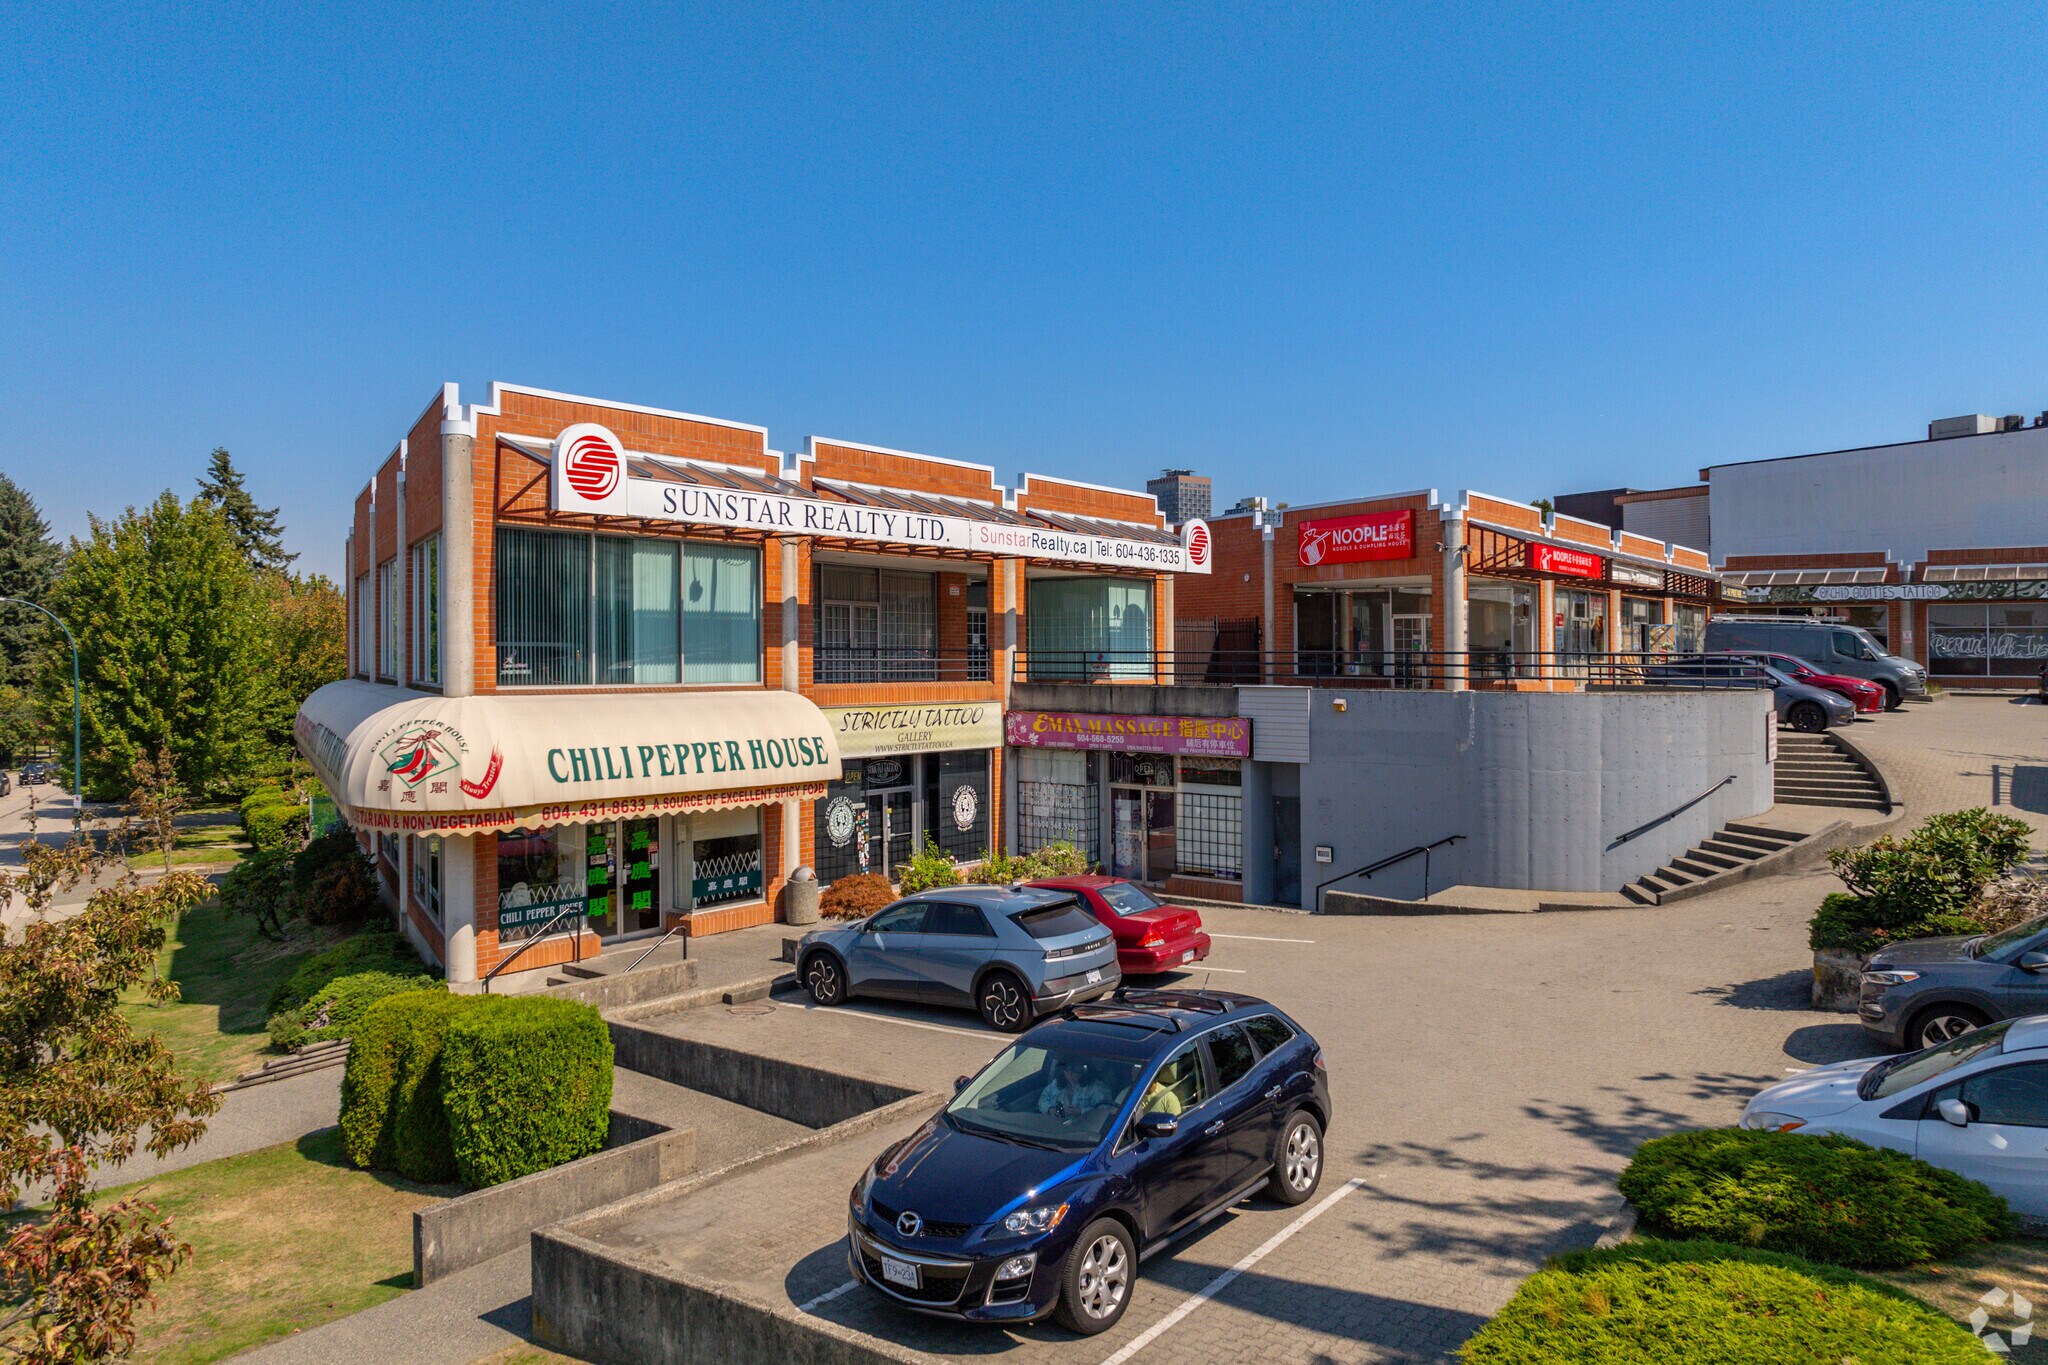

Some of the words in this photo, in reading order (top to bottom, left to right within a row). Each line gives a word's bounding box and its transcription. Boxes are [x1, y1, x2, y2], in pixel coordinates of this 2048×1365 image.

[663, 487, 792, 526] SUNSTAR
[803, 504, 897, 537] REALTY
[905, 516, 950, 543] LTD.
[1332, 525, 1387, 545] NOOPLE
[980, 527, 1087, 556] SunstarRealty.ca
[1096, 540, 1112, 557] Tel:
[1115, 543, 1180, 565] 604-436-1335
[1552, 550, 1572, 564] NOOPLE
[1853, 587, 1894, 598] ODDITIES
[1902, 586, 1940, 598] TATTOO
[840, 709, 922, 732] STRICTLY
[925, 707, 984, 727] TATTOO
[1086, 719, 1174, 737] MASSAGE
[897, 731, 934, 743] GALLERY
[1076, 734, 1125, 744] 604-568-5255
[1178, 719, 1245, 740] 指壓中心
[875, 741, 953, 753] WWW.STRICTLYTATTOO.CA
[547, 746, 634, 783] CHILI
[637, 740, 745, 777] PEPPER
[747, 736, 829, 769] HOUSE
[482, 762, 497, 790] Trusted
[845, 769, 862, 781] OPEN
[1134, 763, 1154, 776] OPEN
[463, 783, 484, 796] Always
[652, 798, 660, 811] A
[662, 793, 703, 809] SOURCE
[705, 792, 719, 806] OF
[721, 788, 772, 804] EXCELLENT
[775, 784, 801, 799] SPICY
[393, 814, 400, 829] &
[402, 810, 515, 830] NON-VEGETARIAN
[500, 912, 523, 925] CHILI
[526, 906, 556, 921] PEPPER
